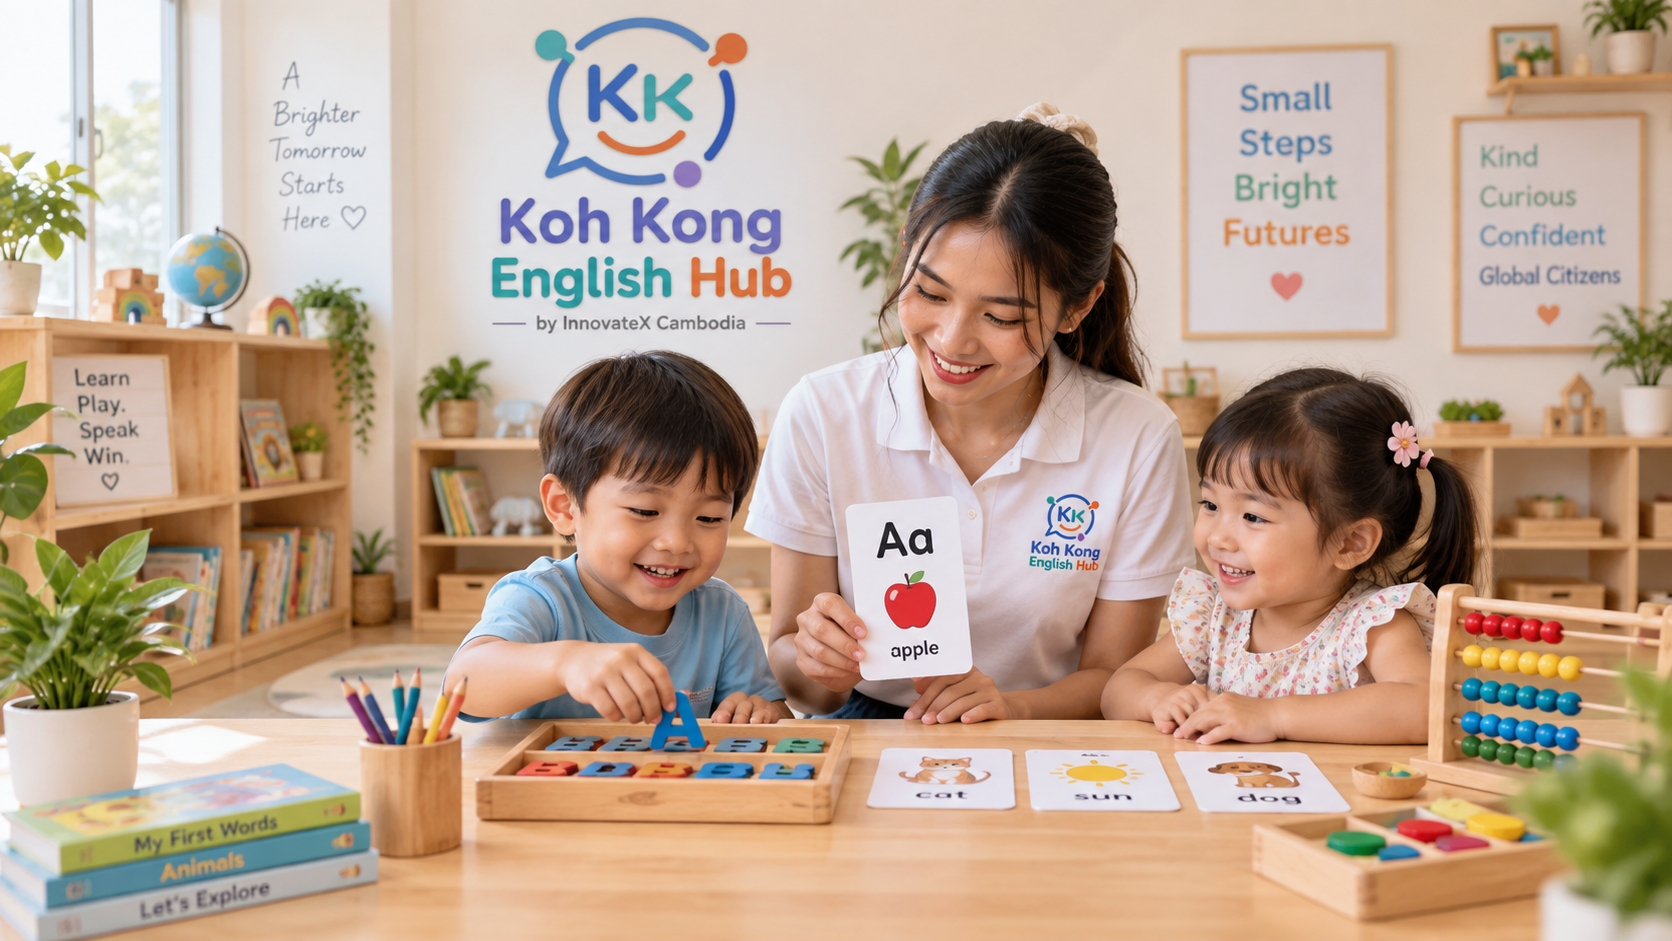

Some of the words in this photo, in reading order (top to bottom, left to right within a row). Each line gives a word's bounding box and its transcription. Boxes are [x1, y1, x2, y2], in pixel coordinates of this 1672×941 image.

[282, 61, 300, 91] A
[1240, 81, 1331, 112] Small
[273, 99, 361, 137] Brighter
[269, 136, 367, 162] Tomorrow
[1240, 129, 1333, 163] Steps
[1480, 144, 1538, 168] Kind
[279, 171, 345, 197] Starts
[1235, 172, 1337, 209] Bright
[1480, 184, 1577, 208] Curious
[282, 205, 331, 231] Here
[500, 197, 610, 244] Koh
[632, 197, 781, 254] Kong
[1223, 218, 1350, 246] Futures
[1480, 223, 1606, 247] Confident
[492, 256, 672, 309] English
[690, 256, 792, 298] Hub
[1479, 265, 1540, 286] Global
[1546, 265, 1621, 285] Citizens
[536, 315, 557, 334] by
[563, 315, 651, 330] InnovateX
[656, 315, 746, 331] Cambodia
[75, 368, 130, 387] Learn
[77, 394, 126, 417] Play.
[79, 420, 139, 443] Speak
[876, 521, 934, 559] Aa
[1031, 540, 1060, 556] Koh
[1064, 543, 1101, 561] Kong
[1029, 555, 1073, 571] English
[1076, 559, 1099, 571] Hub
[890, 640, 940, 661] apple
[915, 791, 968, 799] cat
[1074, 793, 1133, 801] sun
[1237, 793, 1302, 805] dog
[134, 836, 163, 855] My
[170, 826, 214, 847] First
[220, 815, 278, 838] Words
[159, 851, 246, 883] Animals
[140, 894, 189, 920] Let's
[196, 883, 271, 909] Explore
